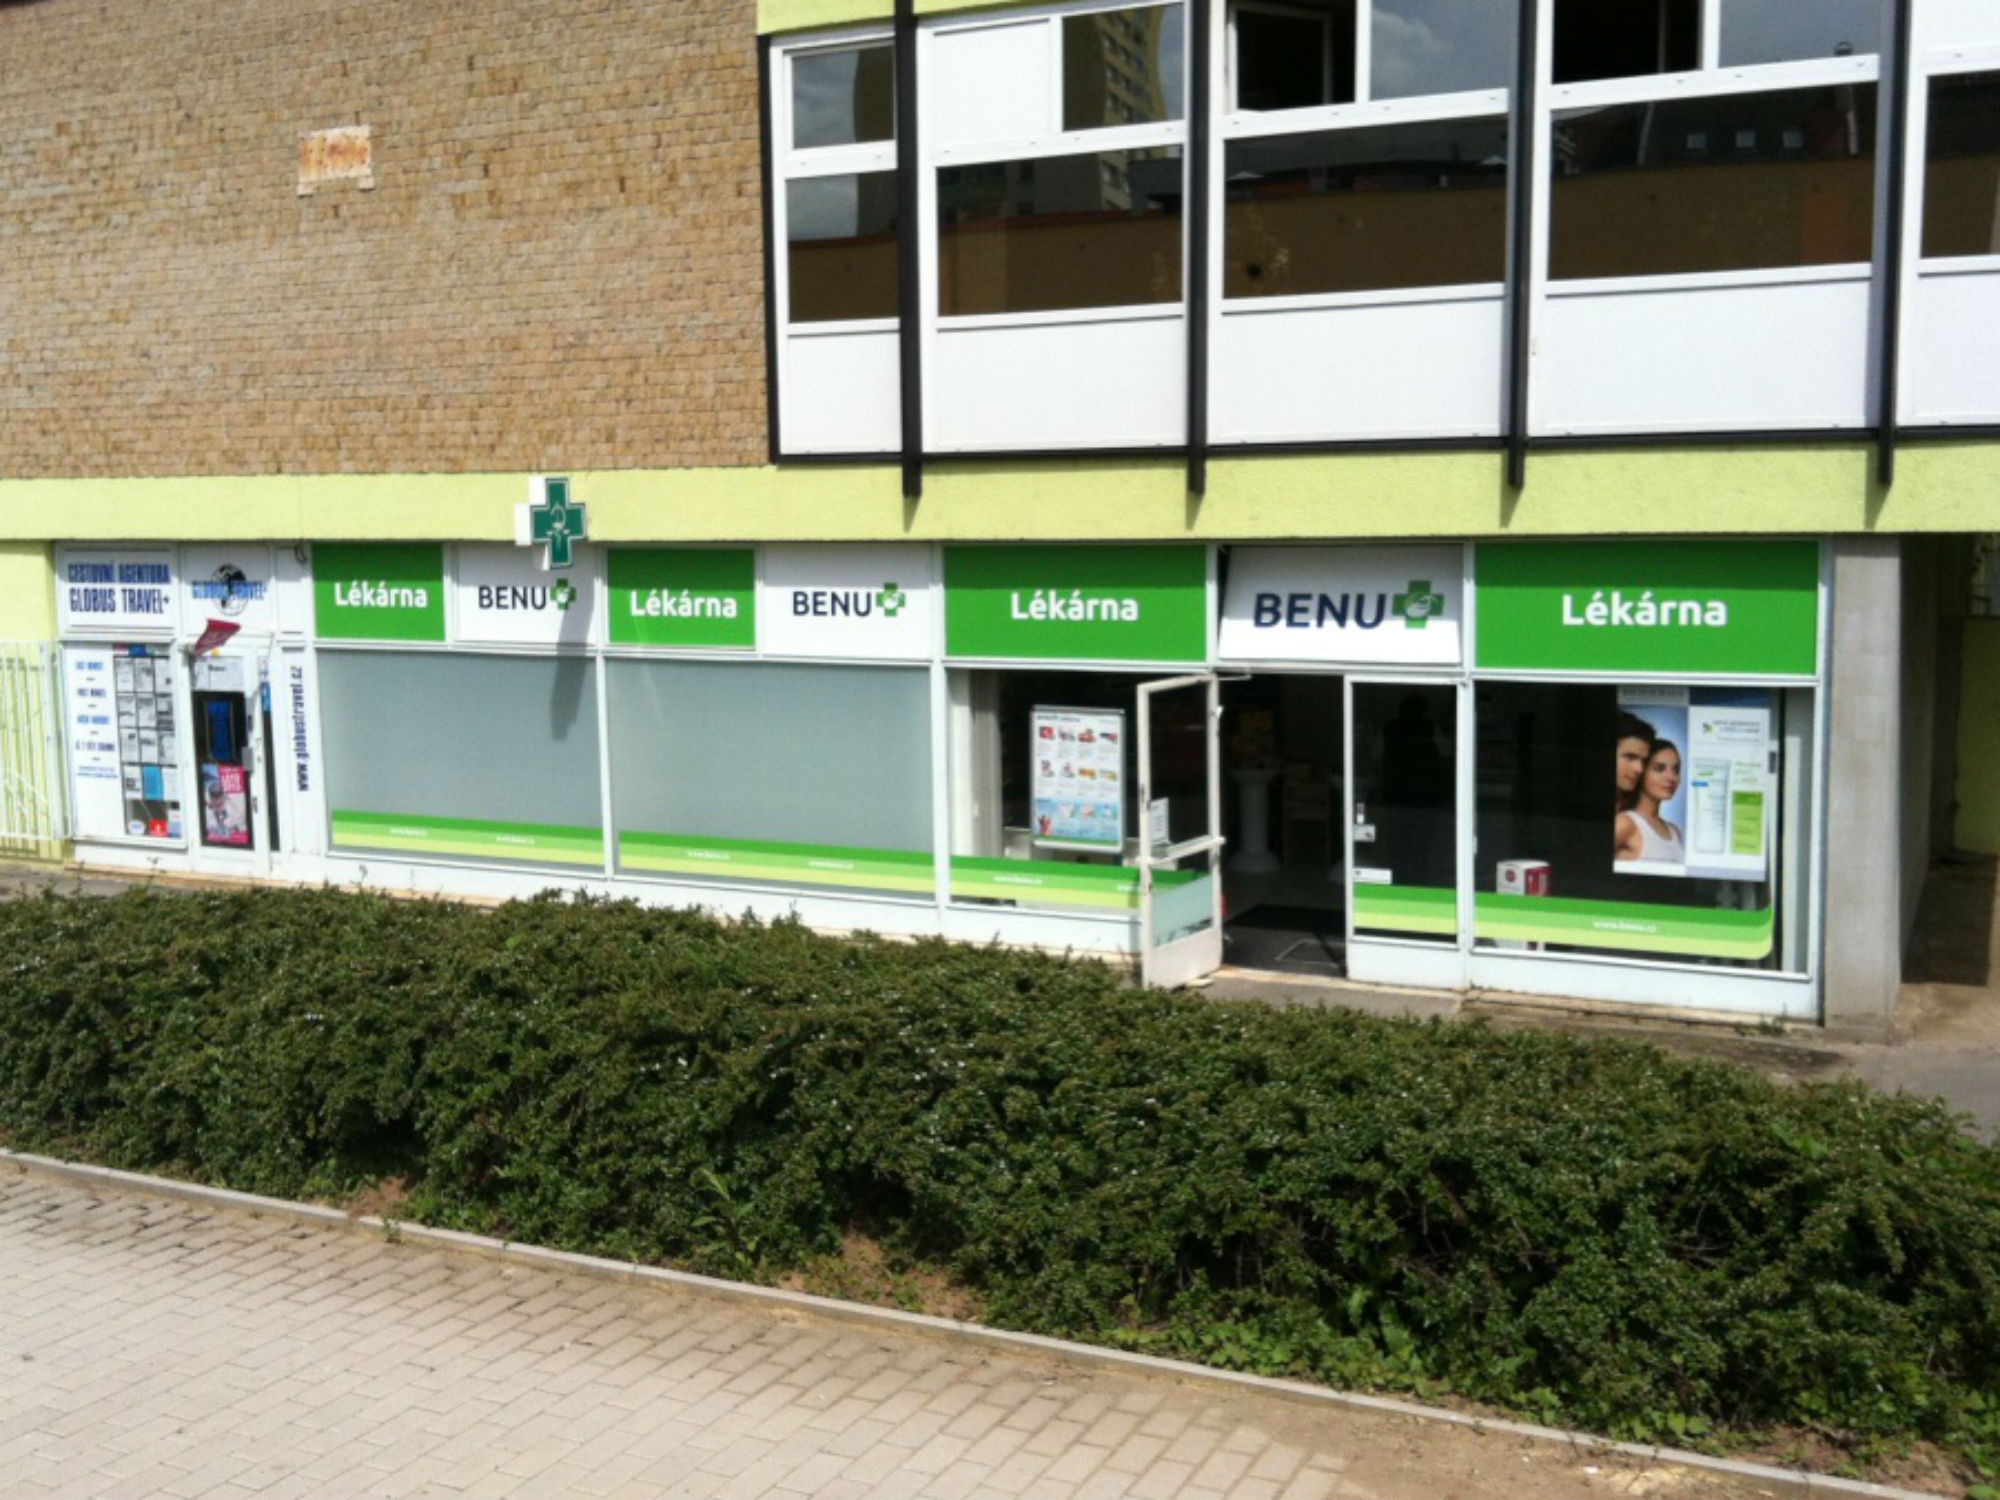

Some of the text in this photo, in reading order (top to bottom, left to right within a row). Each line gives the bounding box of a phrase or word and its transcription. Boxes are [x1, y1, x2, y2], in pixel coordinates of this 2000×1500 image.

[69, 587, 116, 613] GLOBUS
[334, 580, 428, 608] Lékárna
[478, 585, 547, 610] BENU
[630, 588, 738, 618] Lékárna
[792, 591, 872, 617] BENU
[1010, 589, 1139, 621] Lékárna
[1562, 590, 1727, 626] Lékárna
[1253, 592, 1387, 630] BENU
